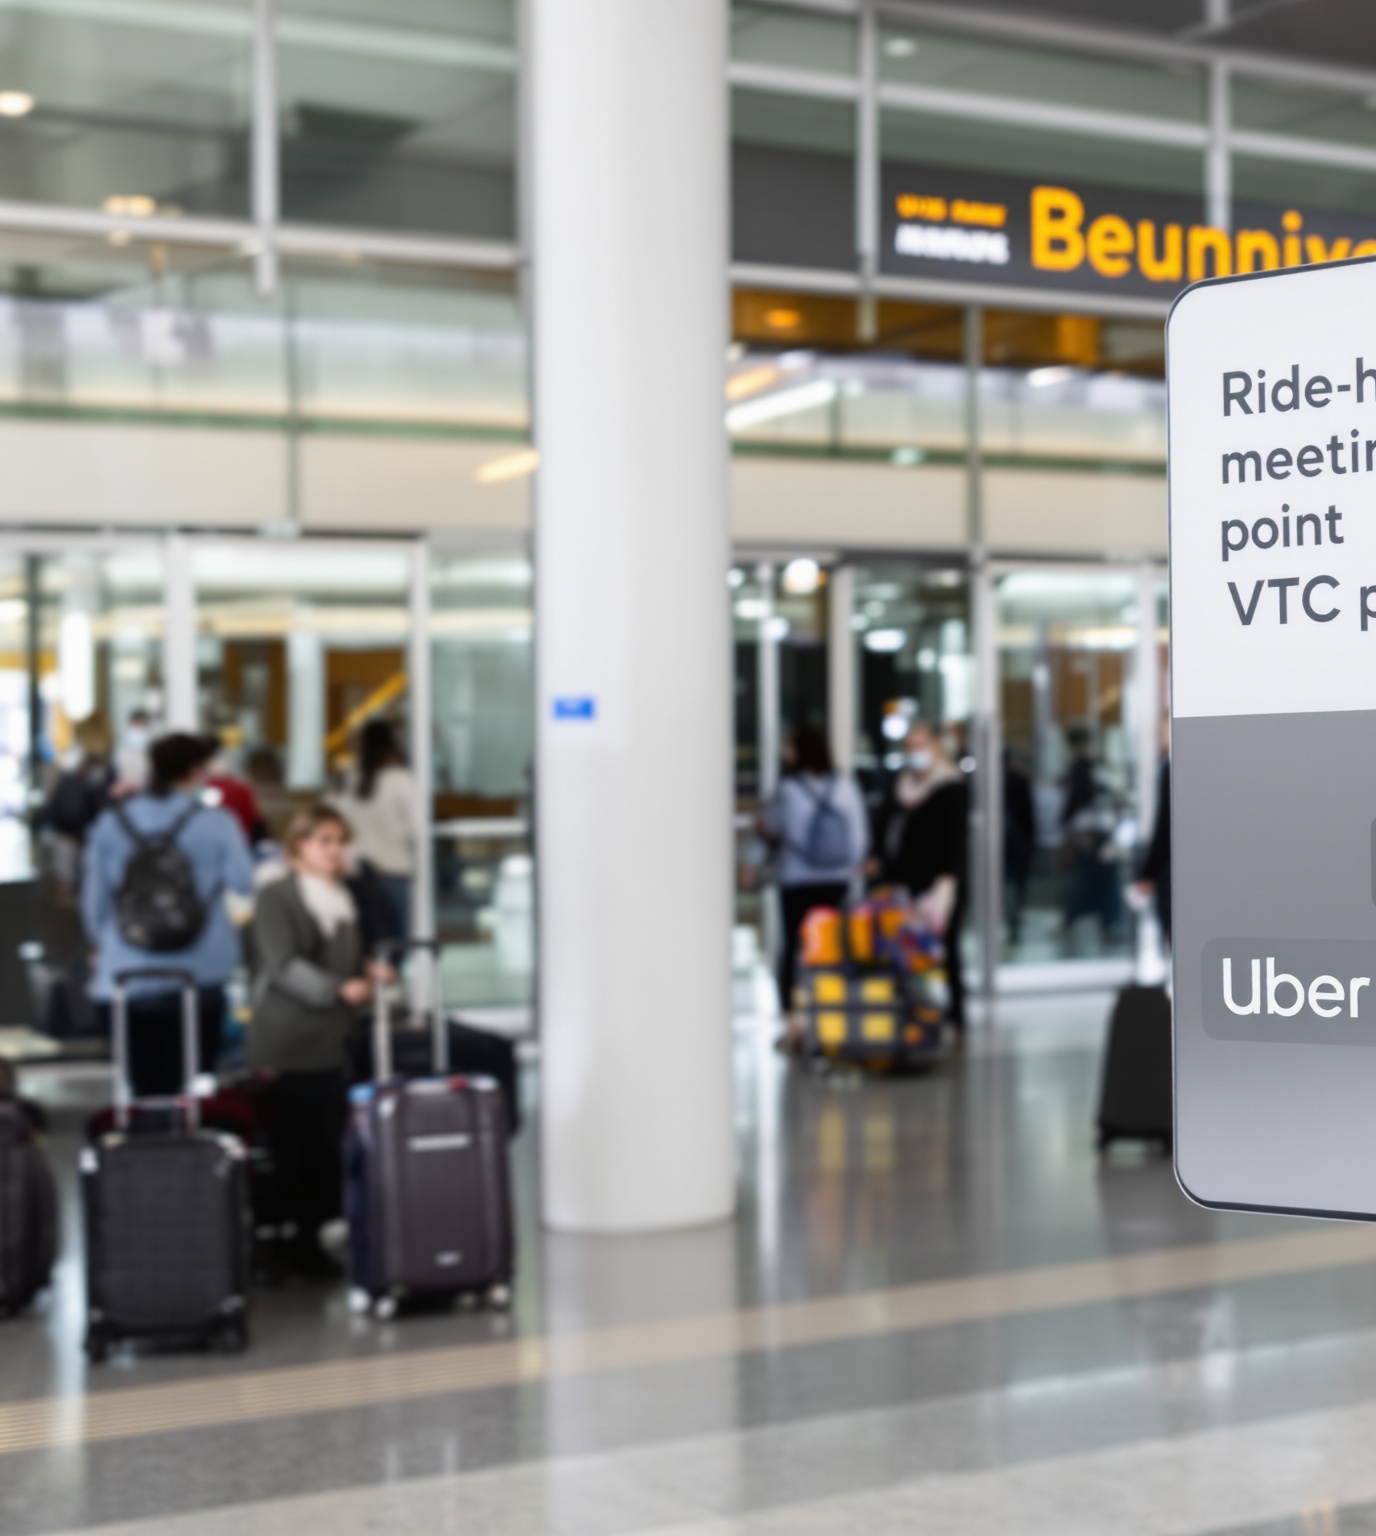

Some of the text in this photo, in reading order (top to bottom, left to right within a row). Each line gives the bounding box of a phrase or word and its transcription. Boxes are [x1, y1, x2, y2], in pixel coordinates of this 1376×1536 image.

[1221, 503, 1344, 562] point
[1226, 575, 1341, 626] VTC
[1221, 957, 1371, 1018] Uber
